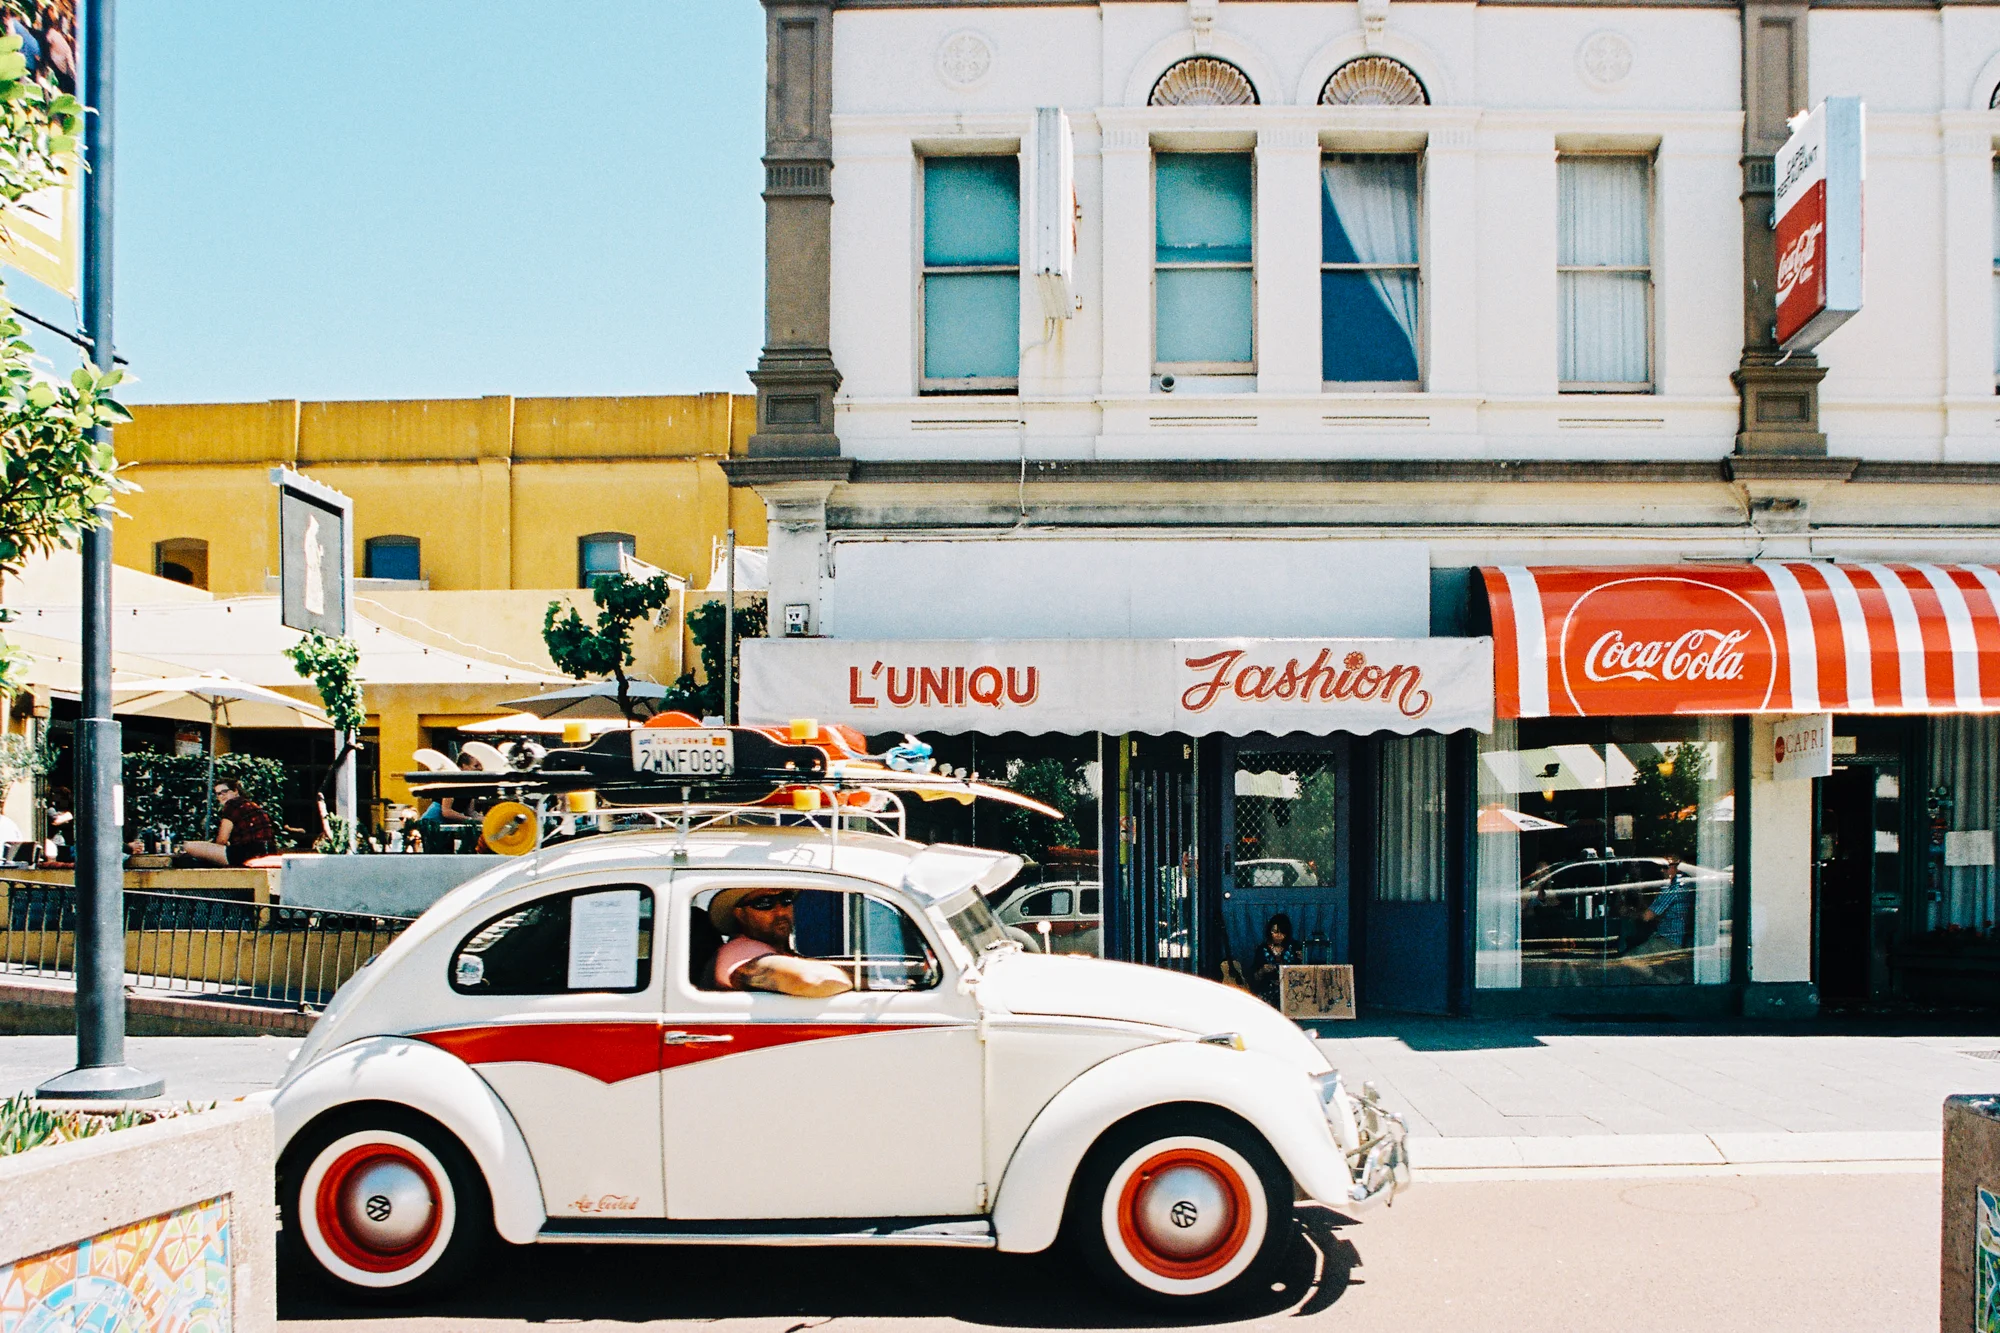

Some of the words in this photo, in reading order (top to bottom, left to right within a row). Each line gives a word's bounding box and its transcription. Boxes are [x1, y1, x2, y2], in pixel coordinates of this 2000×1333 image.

[1584, 629, 1751, 682] Coca-Cola
[850, 660, 1040, 708] L'UNIQU
[1182, 648, 1433, 719] Fashion
[1786, 728, 1824, 753] CAPRI
